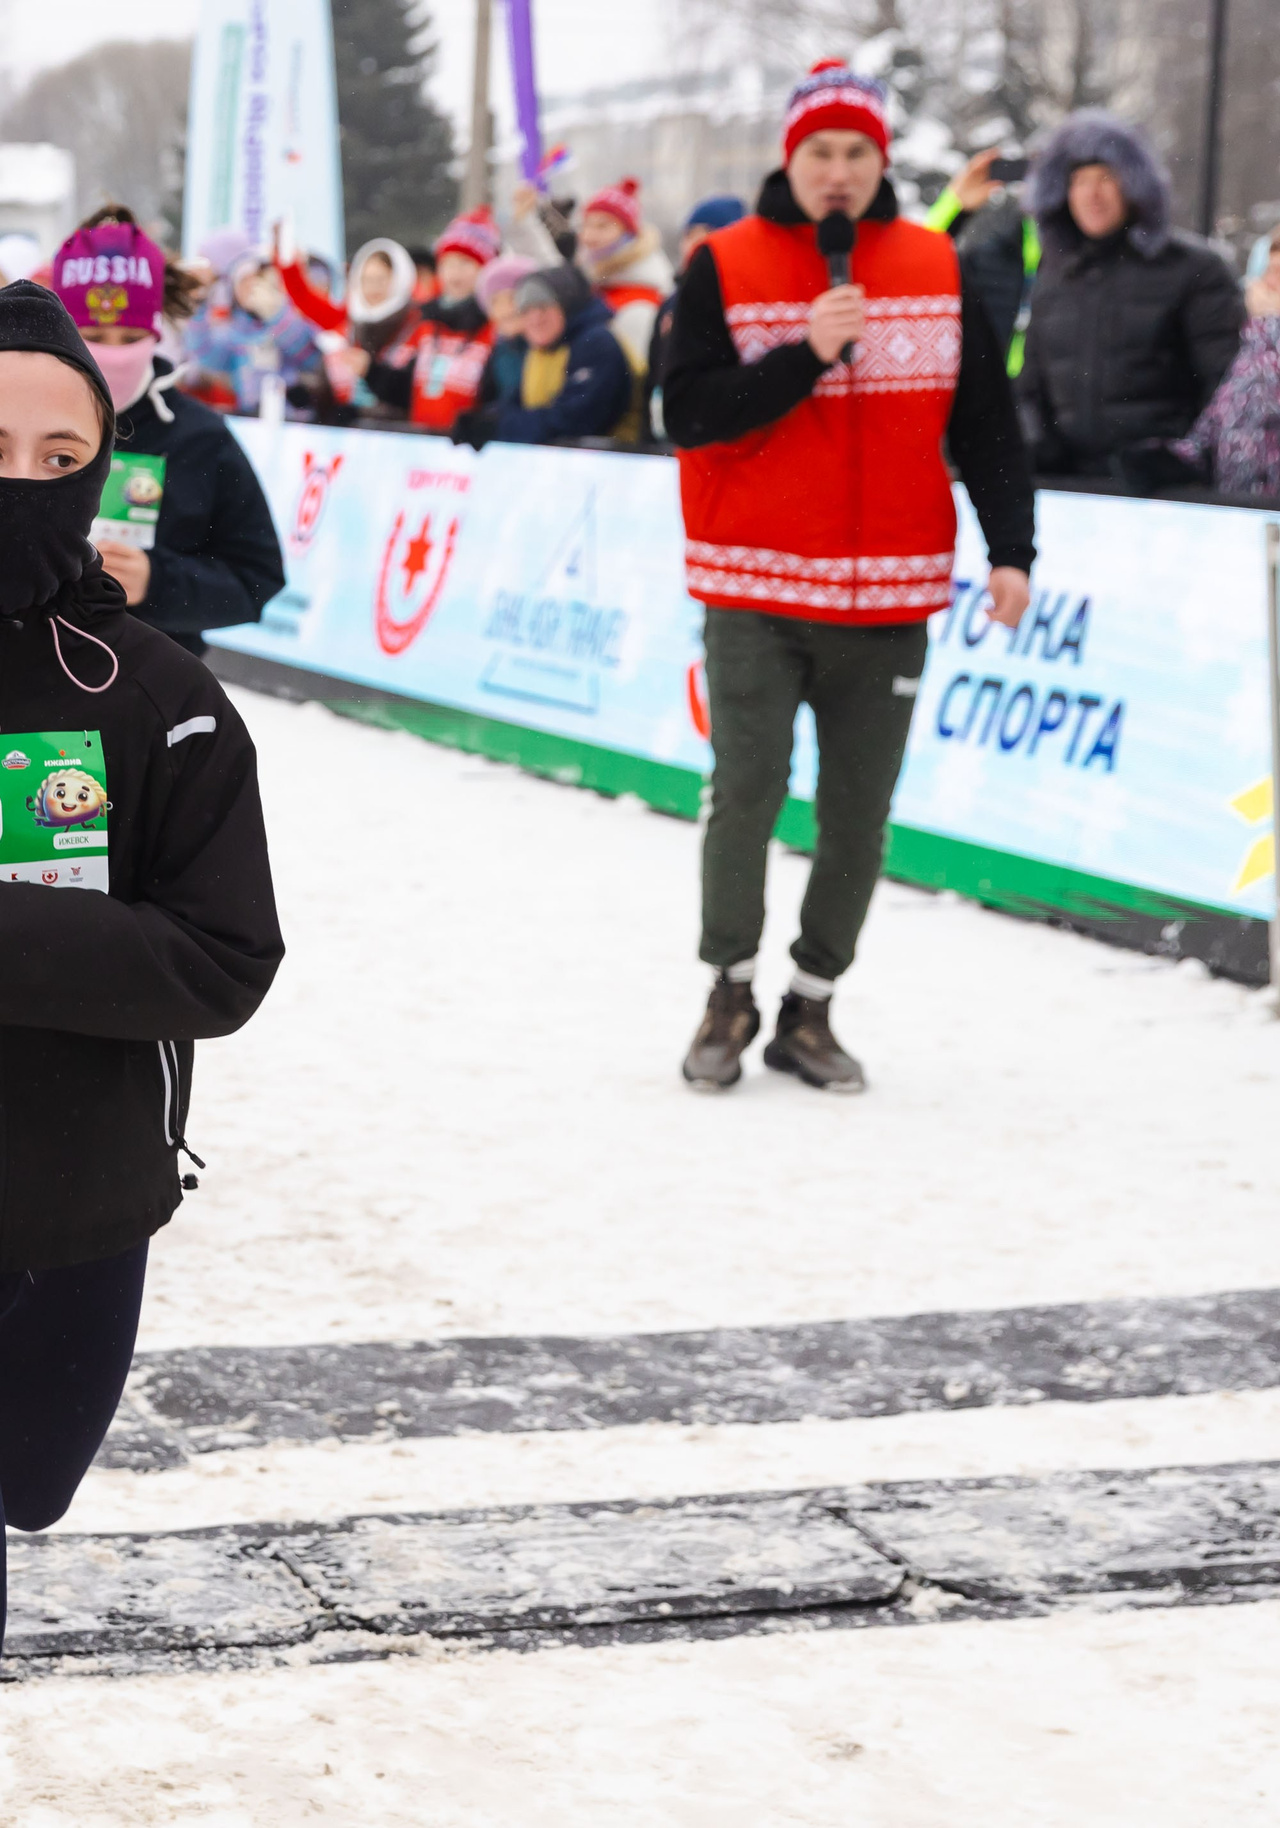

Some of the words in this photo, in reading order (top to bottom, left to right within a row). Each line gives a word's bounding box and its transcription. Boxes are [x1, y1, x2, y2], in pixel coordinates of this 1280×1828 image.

[61, 255, 153, 288] RUSSIA
[935, 673, 1129, 774] СПОРТА
[58, 836, 89, 846] ИЖЕВСК
